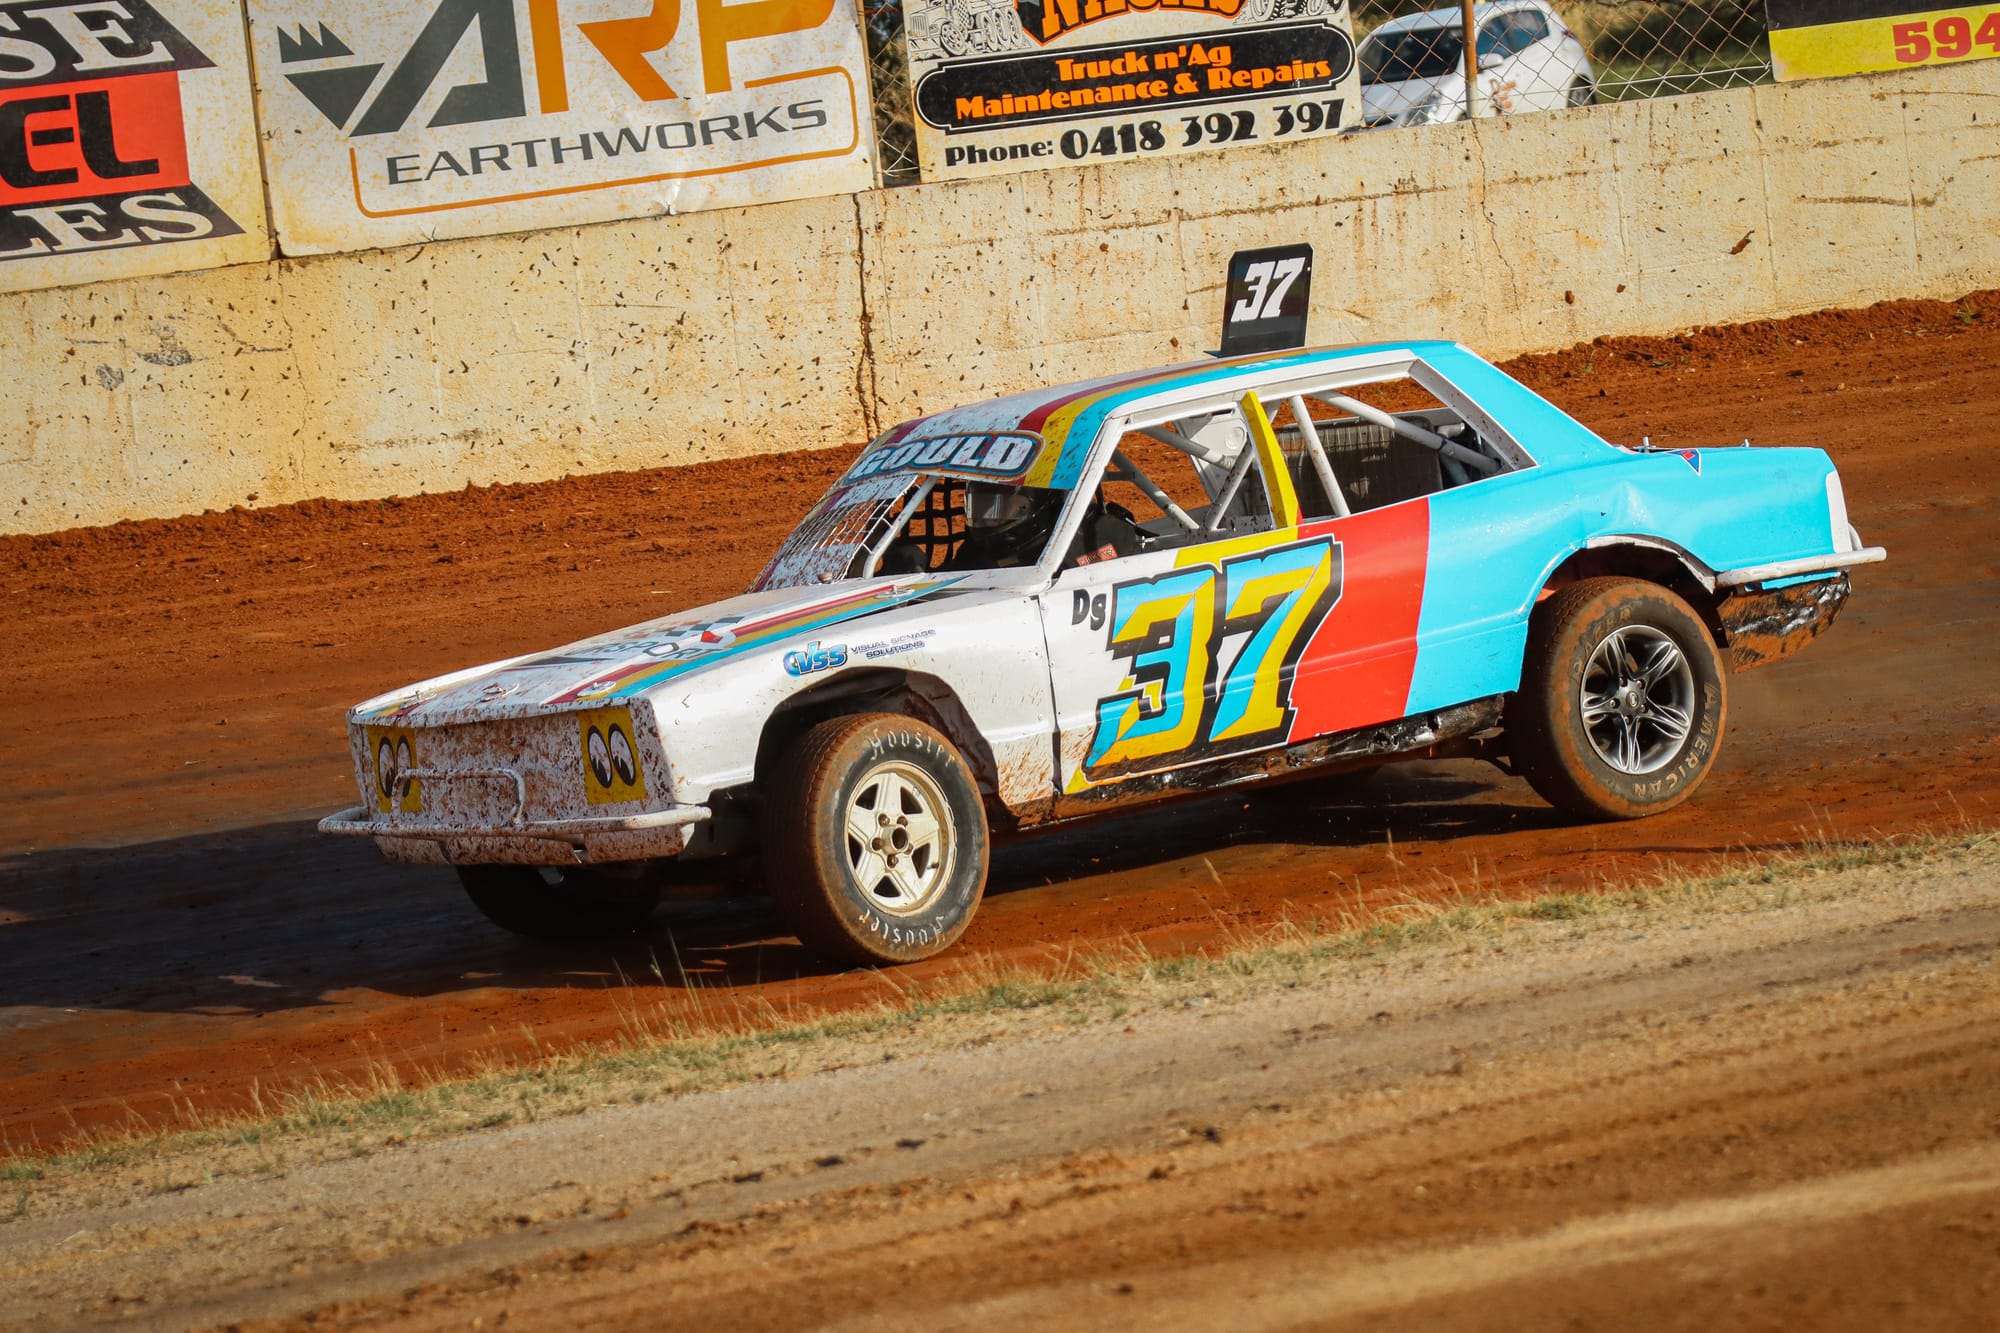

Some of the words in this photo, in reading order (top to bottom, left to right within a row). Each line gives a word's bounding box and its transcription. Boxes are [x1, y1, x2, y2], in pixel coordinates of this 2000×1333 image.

[955, 78, 1169, 120] Maintenance
[1173, 71, 1199, 95] &
[1207, 59, 1332, 90] Repairs
[1056, 51, 1149, 82] Truck
[387, 99, 827, 185] EARTHWORKS
[945, 140, 1053, 167] Phone:
[1059, 120, 1166, 160] 0418
[1181, 110, 1258, 147] 392
[1273, 98, 1345, 136] 397
[1230, 256, 1306, 323] 37
[848, 436, 1034, 480] GOULD
[851, 640, 890, 654] VISUAL
[866, 640, 925, 660] SOLUTIONS
[1083, 535, 1342, 779] 37
[1634, 682, 1721, 795] AMERICAN
